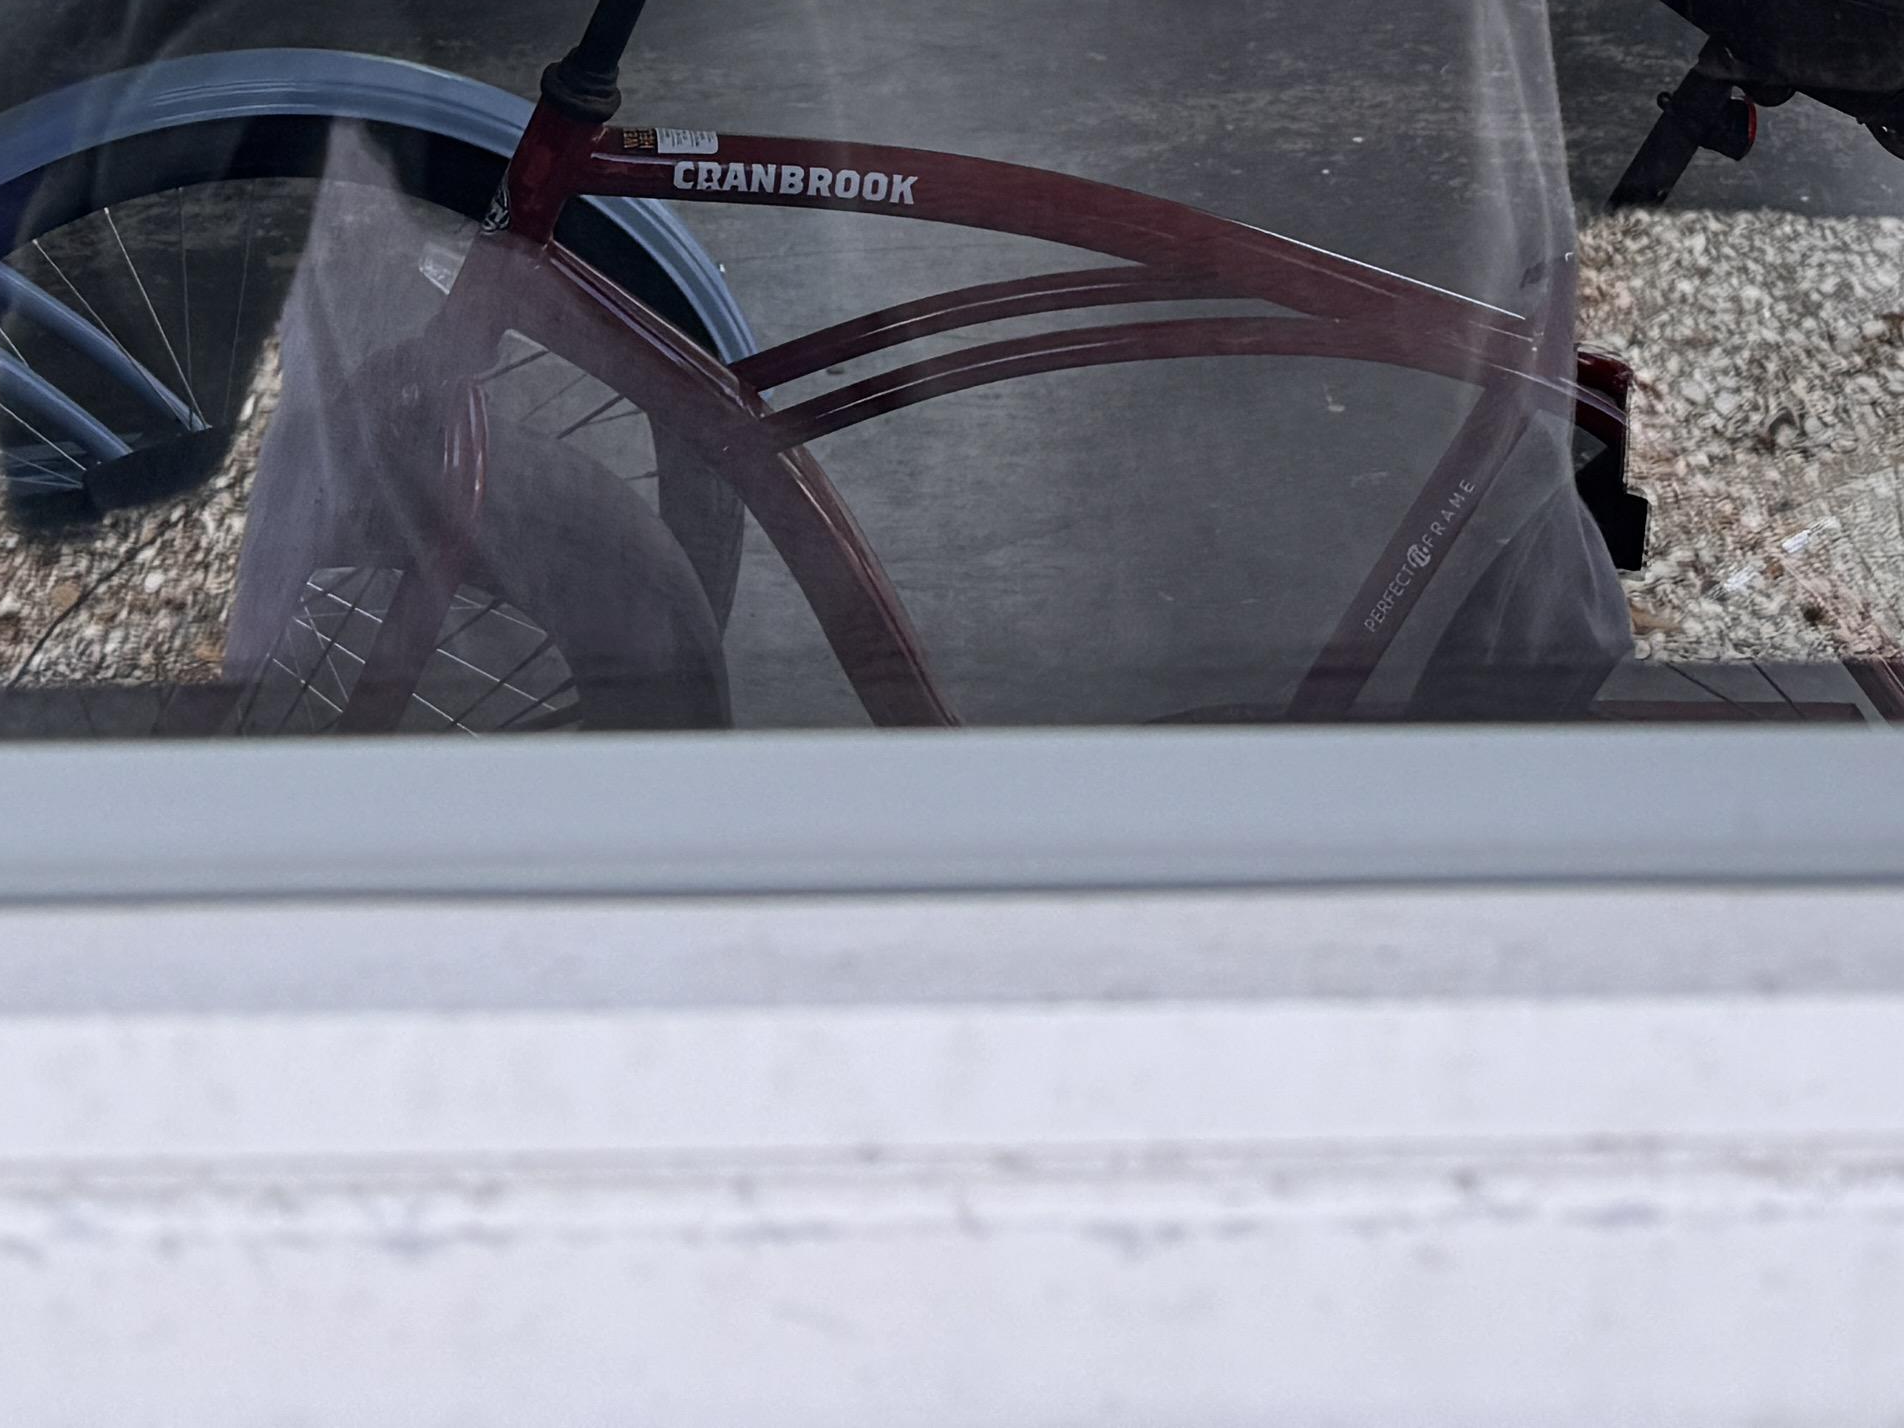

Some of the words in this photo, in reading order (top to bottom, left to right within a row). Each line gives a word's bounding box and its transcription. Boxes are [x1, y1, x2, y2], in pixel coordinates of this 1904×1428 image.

[673, 160, 920, 205] CRANBROOK
[1362, 563, 1415, 633] PERFECT
[1421, 478, 1477, 548] FRAME
